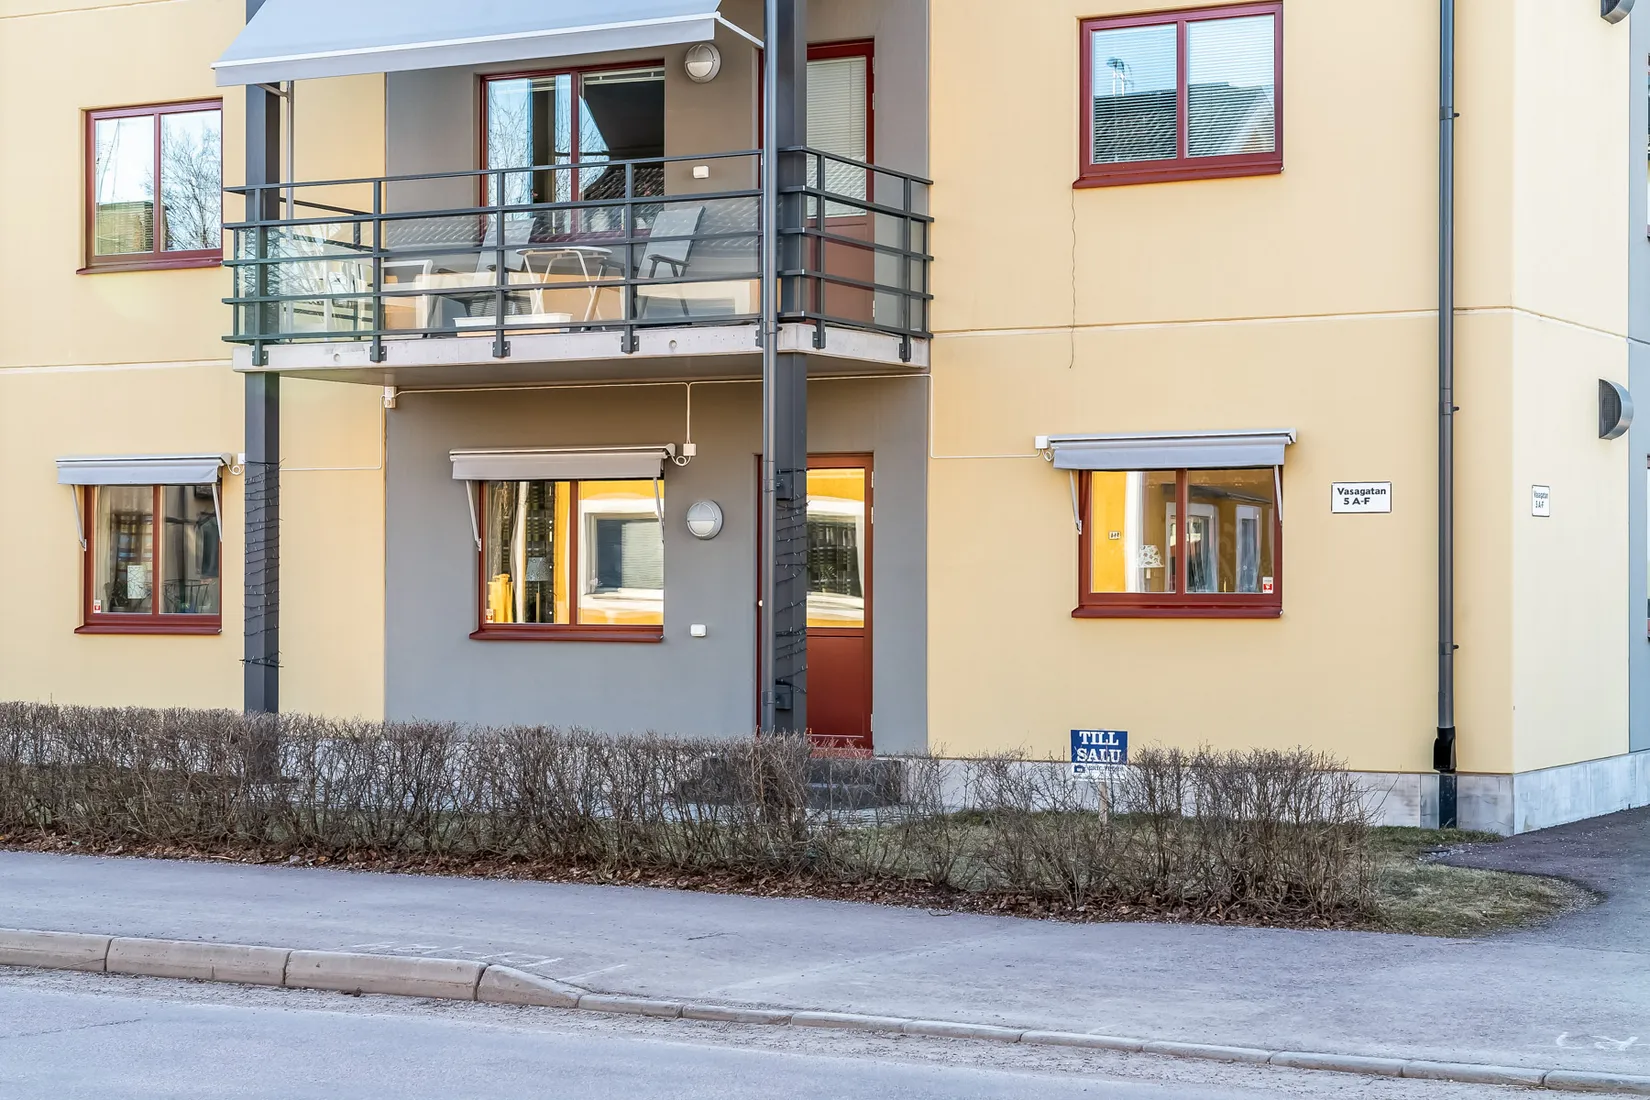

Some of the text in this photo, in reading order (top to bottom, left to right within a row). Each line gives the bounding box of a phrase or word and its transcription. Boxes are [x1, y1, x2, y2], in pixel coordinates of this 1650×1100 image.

[1337, 487, 1387, 496] Vasagatan
[1343, 497, 1371, 505] 5 A-F
[1079, 731, 1119, 745] TILL
[1076, 748, 1122, 763] SALU
